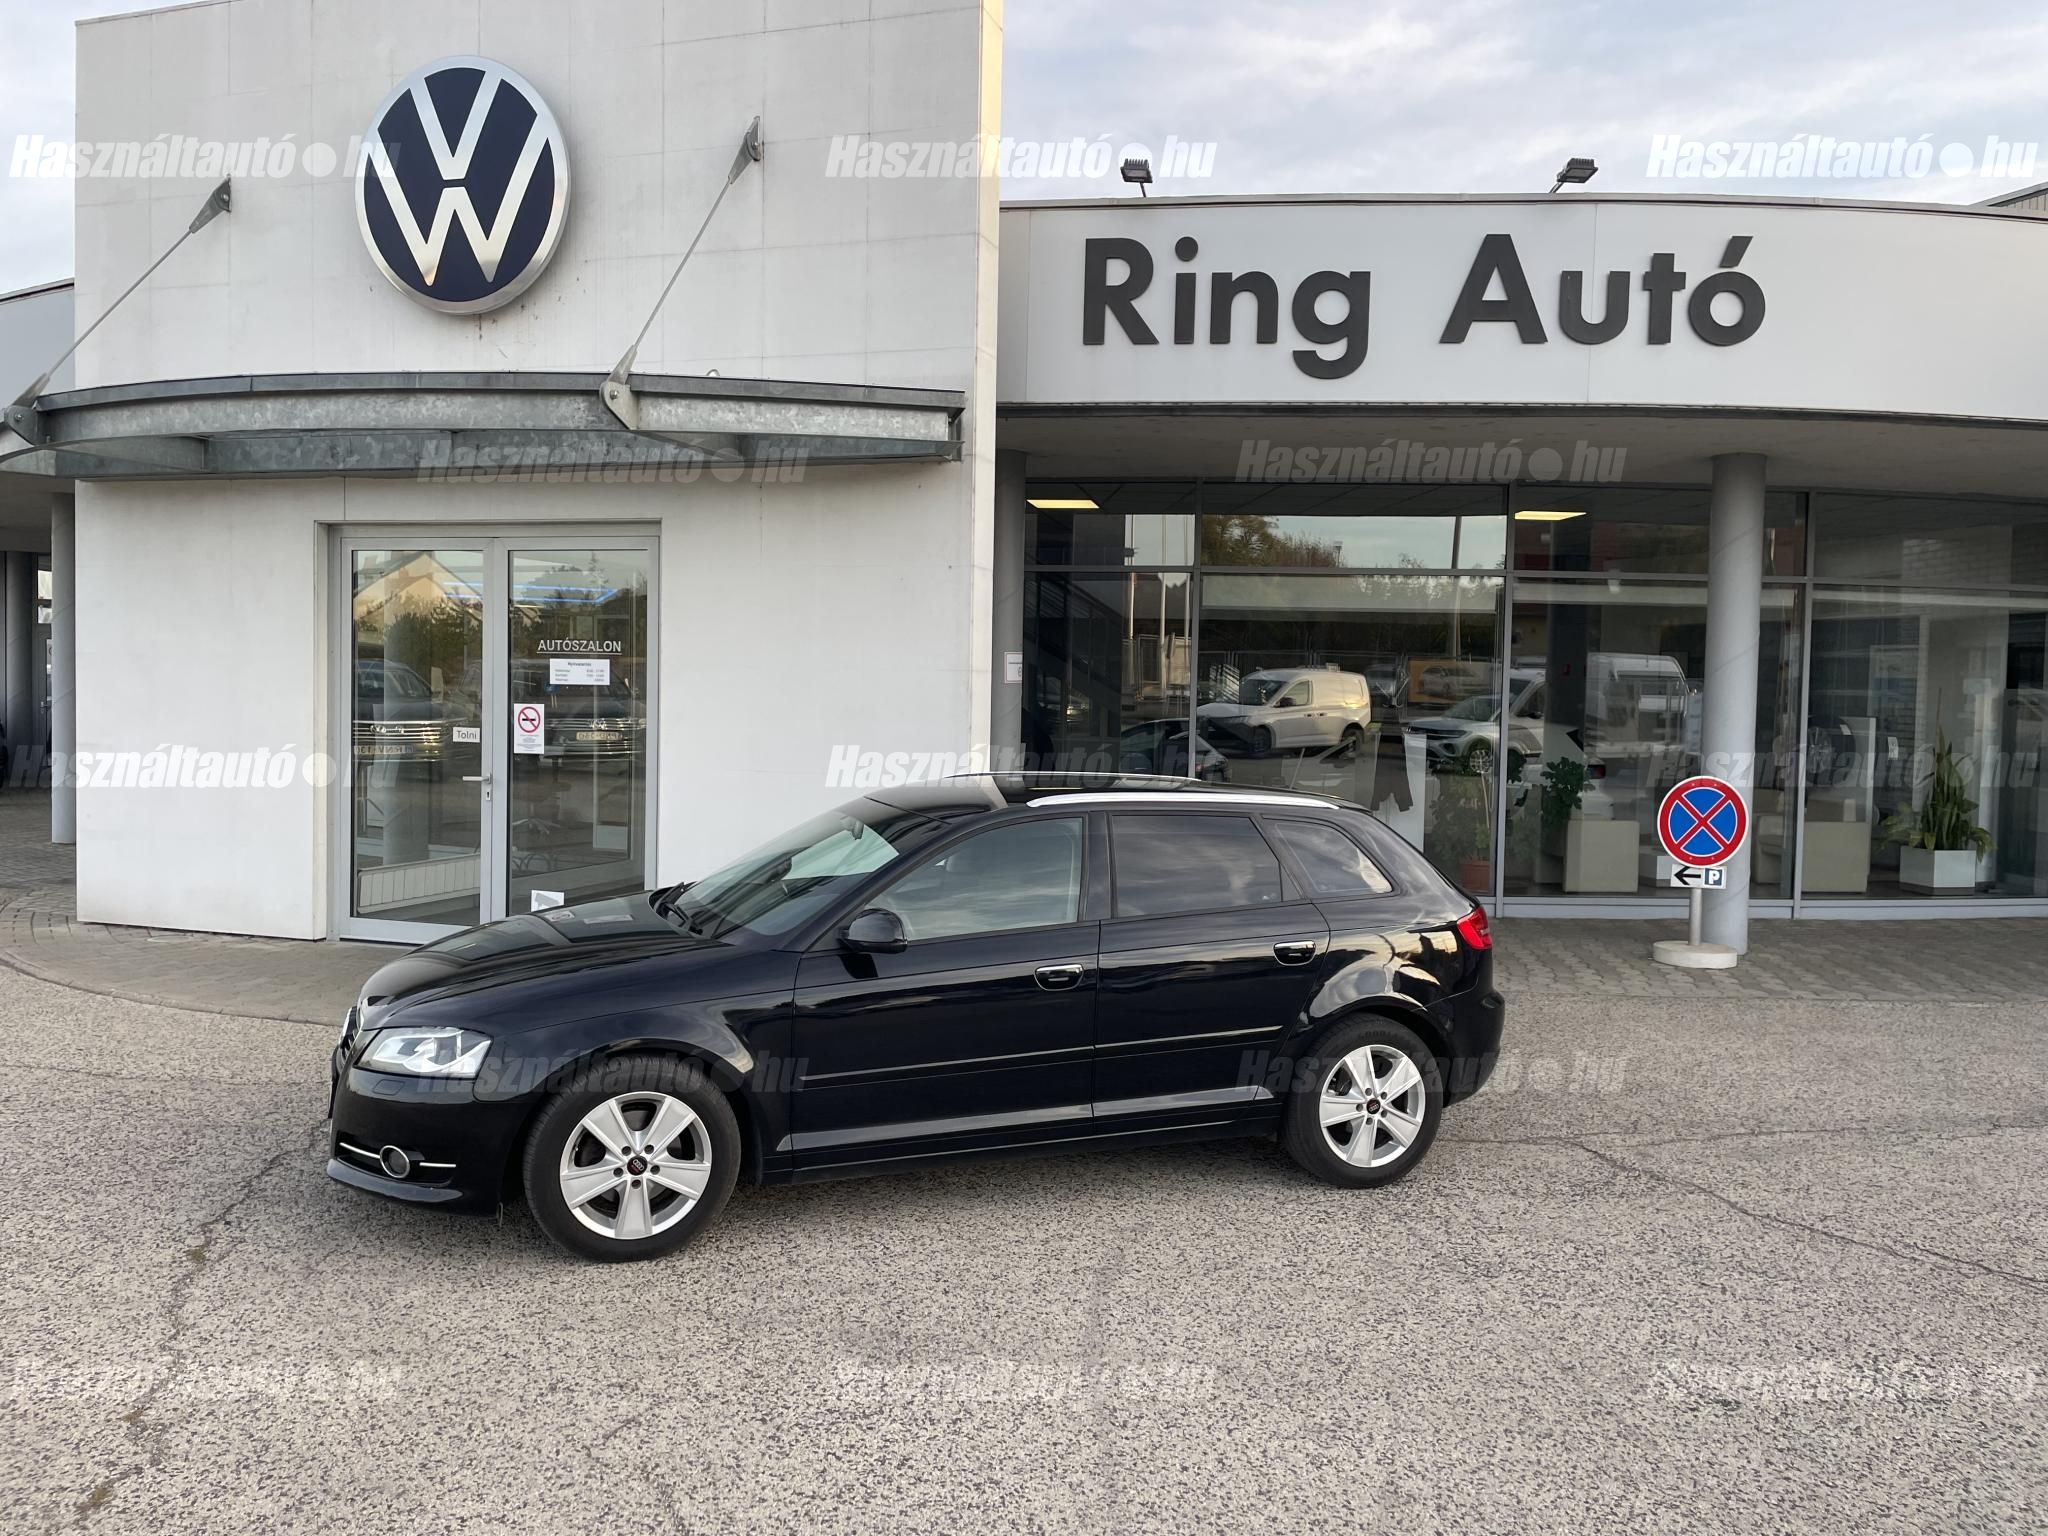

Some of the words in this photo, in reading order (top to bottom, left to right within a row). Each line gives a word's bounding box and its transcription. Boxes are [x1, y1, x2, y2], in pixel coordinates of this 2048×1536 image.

[1082, 236, 1371, 379] Ring
[1439, 234, 1766, 347] Autó
[537, 637, 622, 653] AUTÓSZALON
[456, 730, 477, 740] Tolni
[1708, 870, 1720, 885] P
